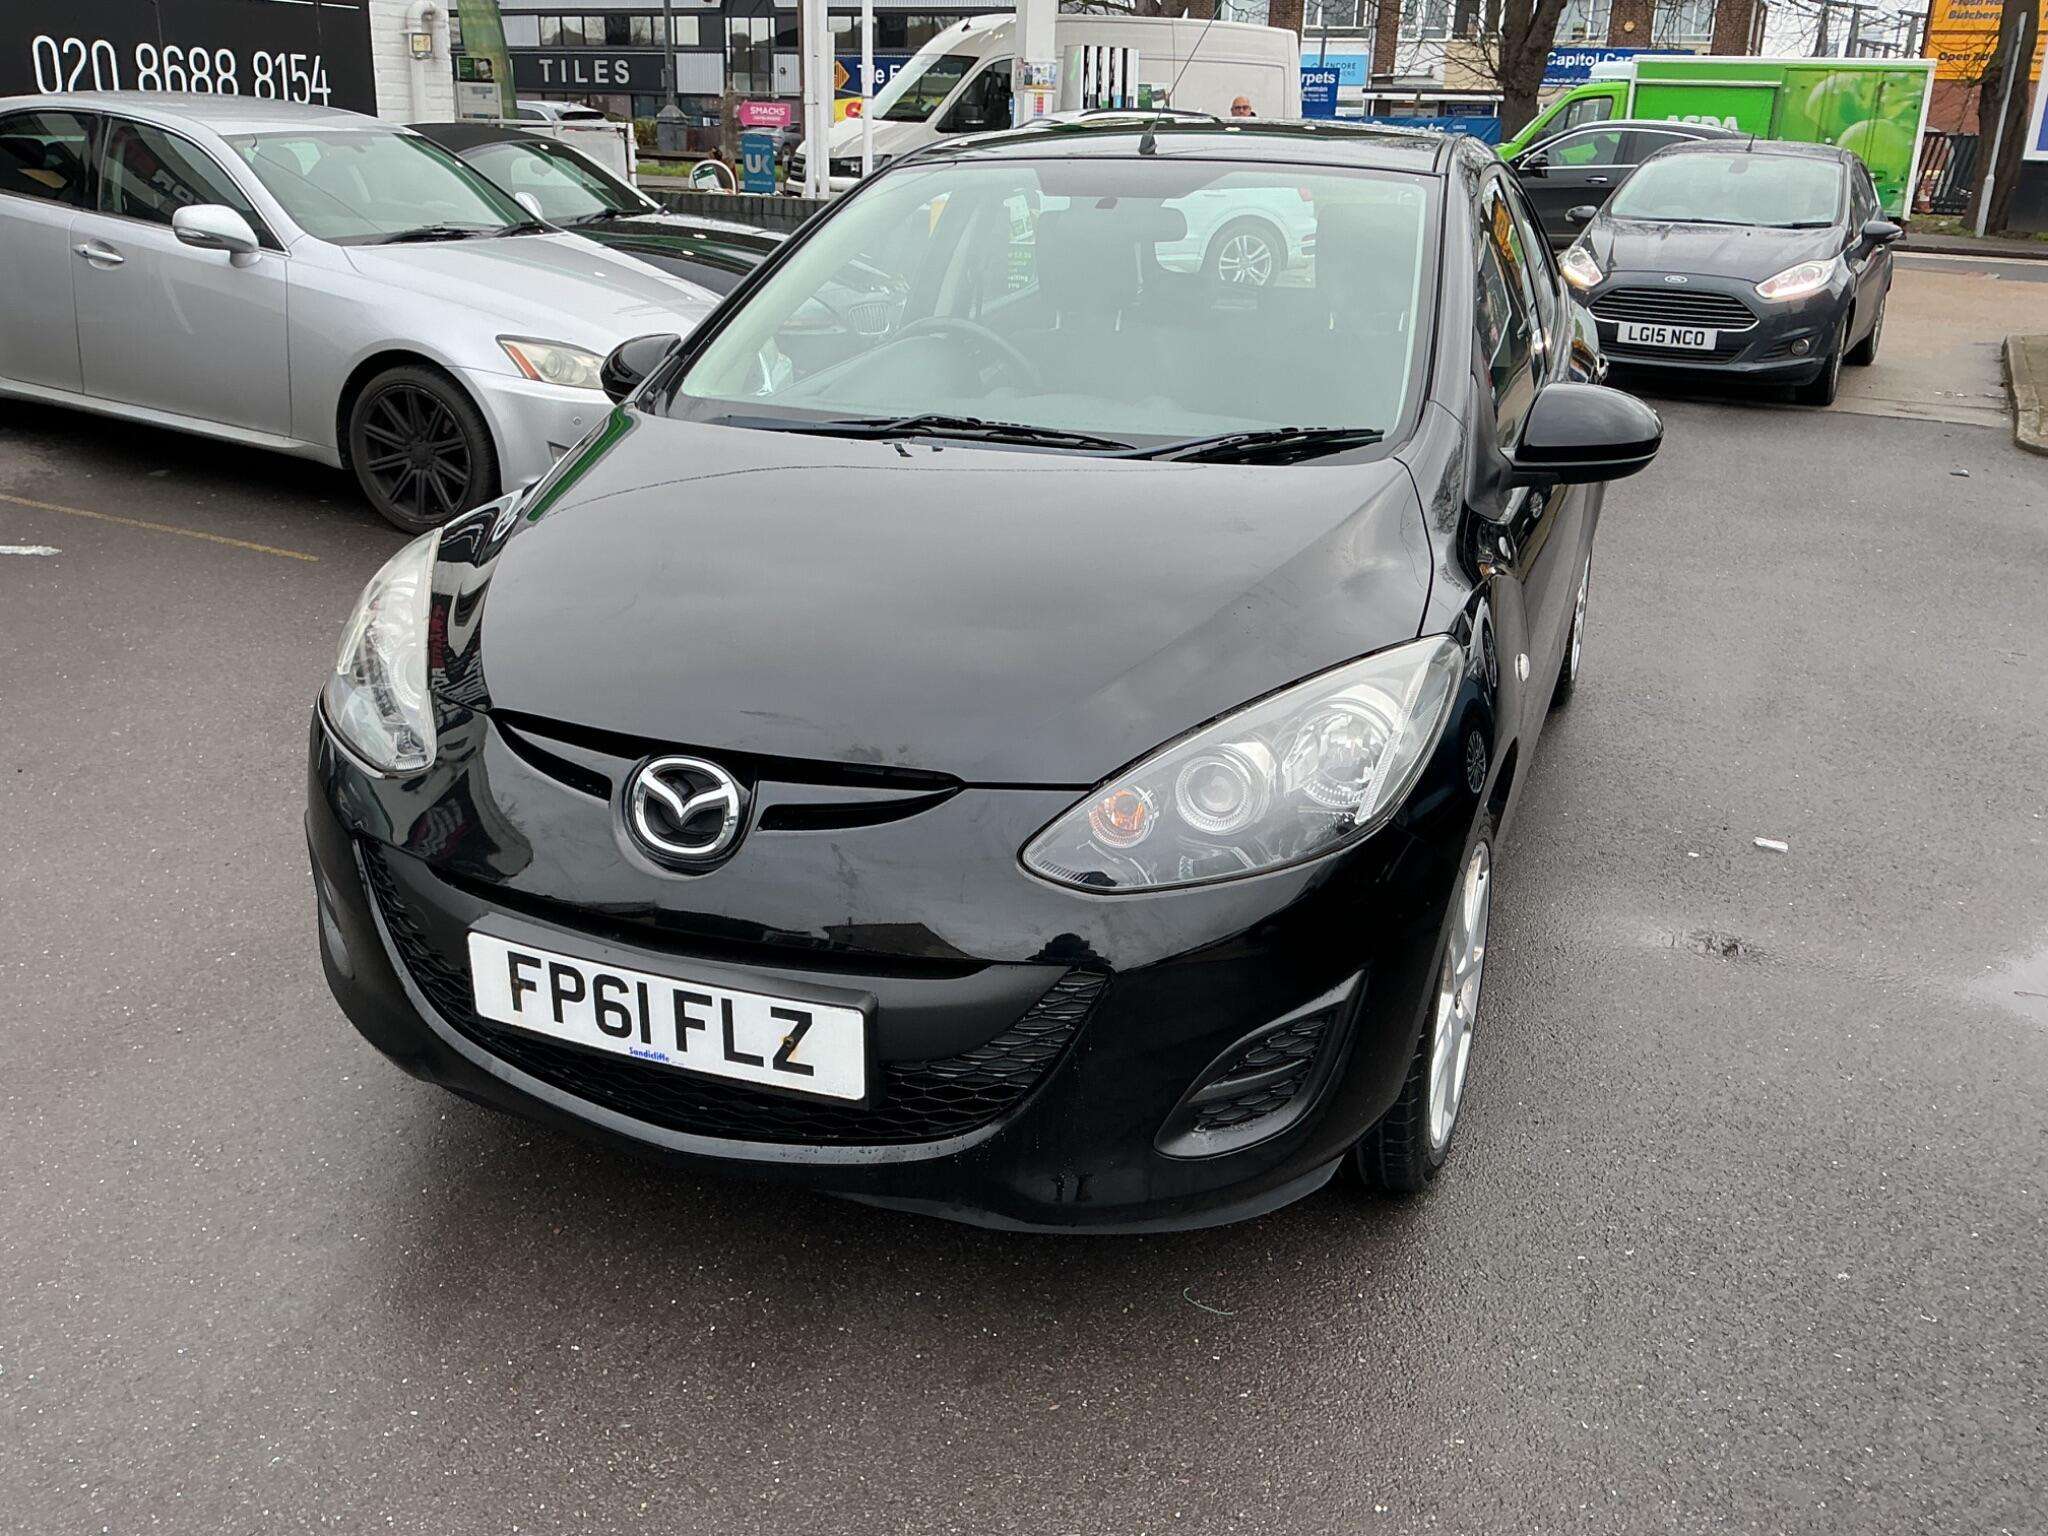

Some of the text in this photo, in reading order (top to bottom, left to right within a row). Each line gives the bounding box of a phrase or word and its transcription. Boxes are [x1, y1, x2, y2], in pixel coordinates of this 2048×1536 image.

[32, 34, 332, 107] 020 8688 8154
[1546, 51, 1600, 69] Capitol
[538, 59, 631, 84] TILES
[1301, 71, 1336, 86] rpets
[750, 106, 786, 116] SMACKS
[1628, 325, 1706, 346] LG15 NCO
[507, 950, 815, 1077] FP61 FLZ
